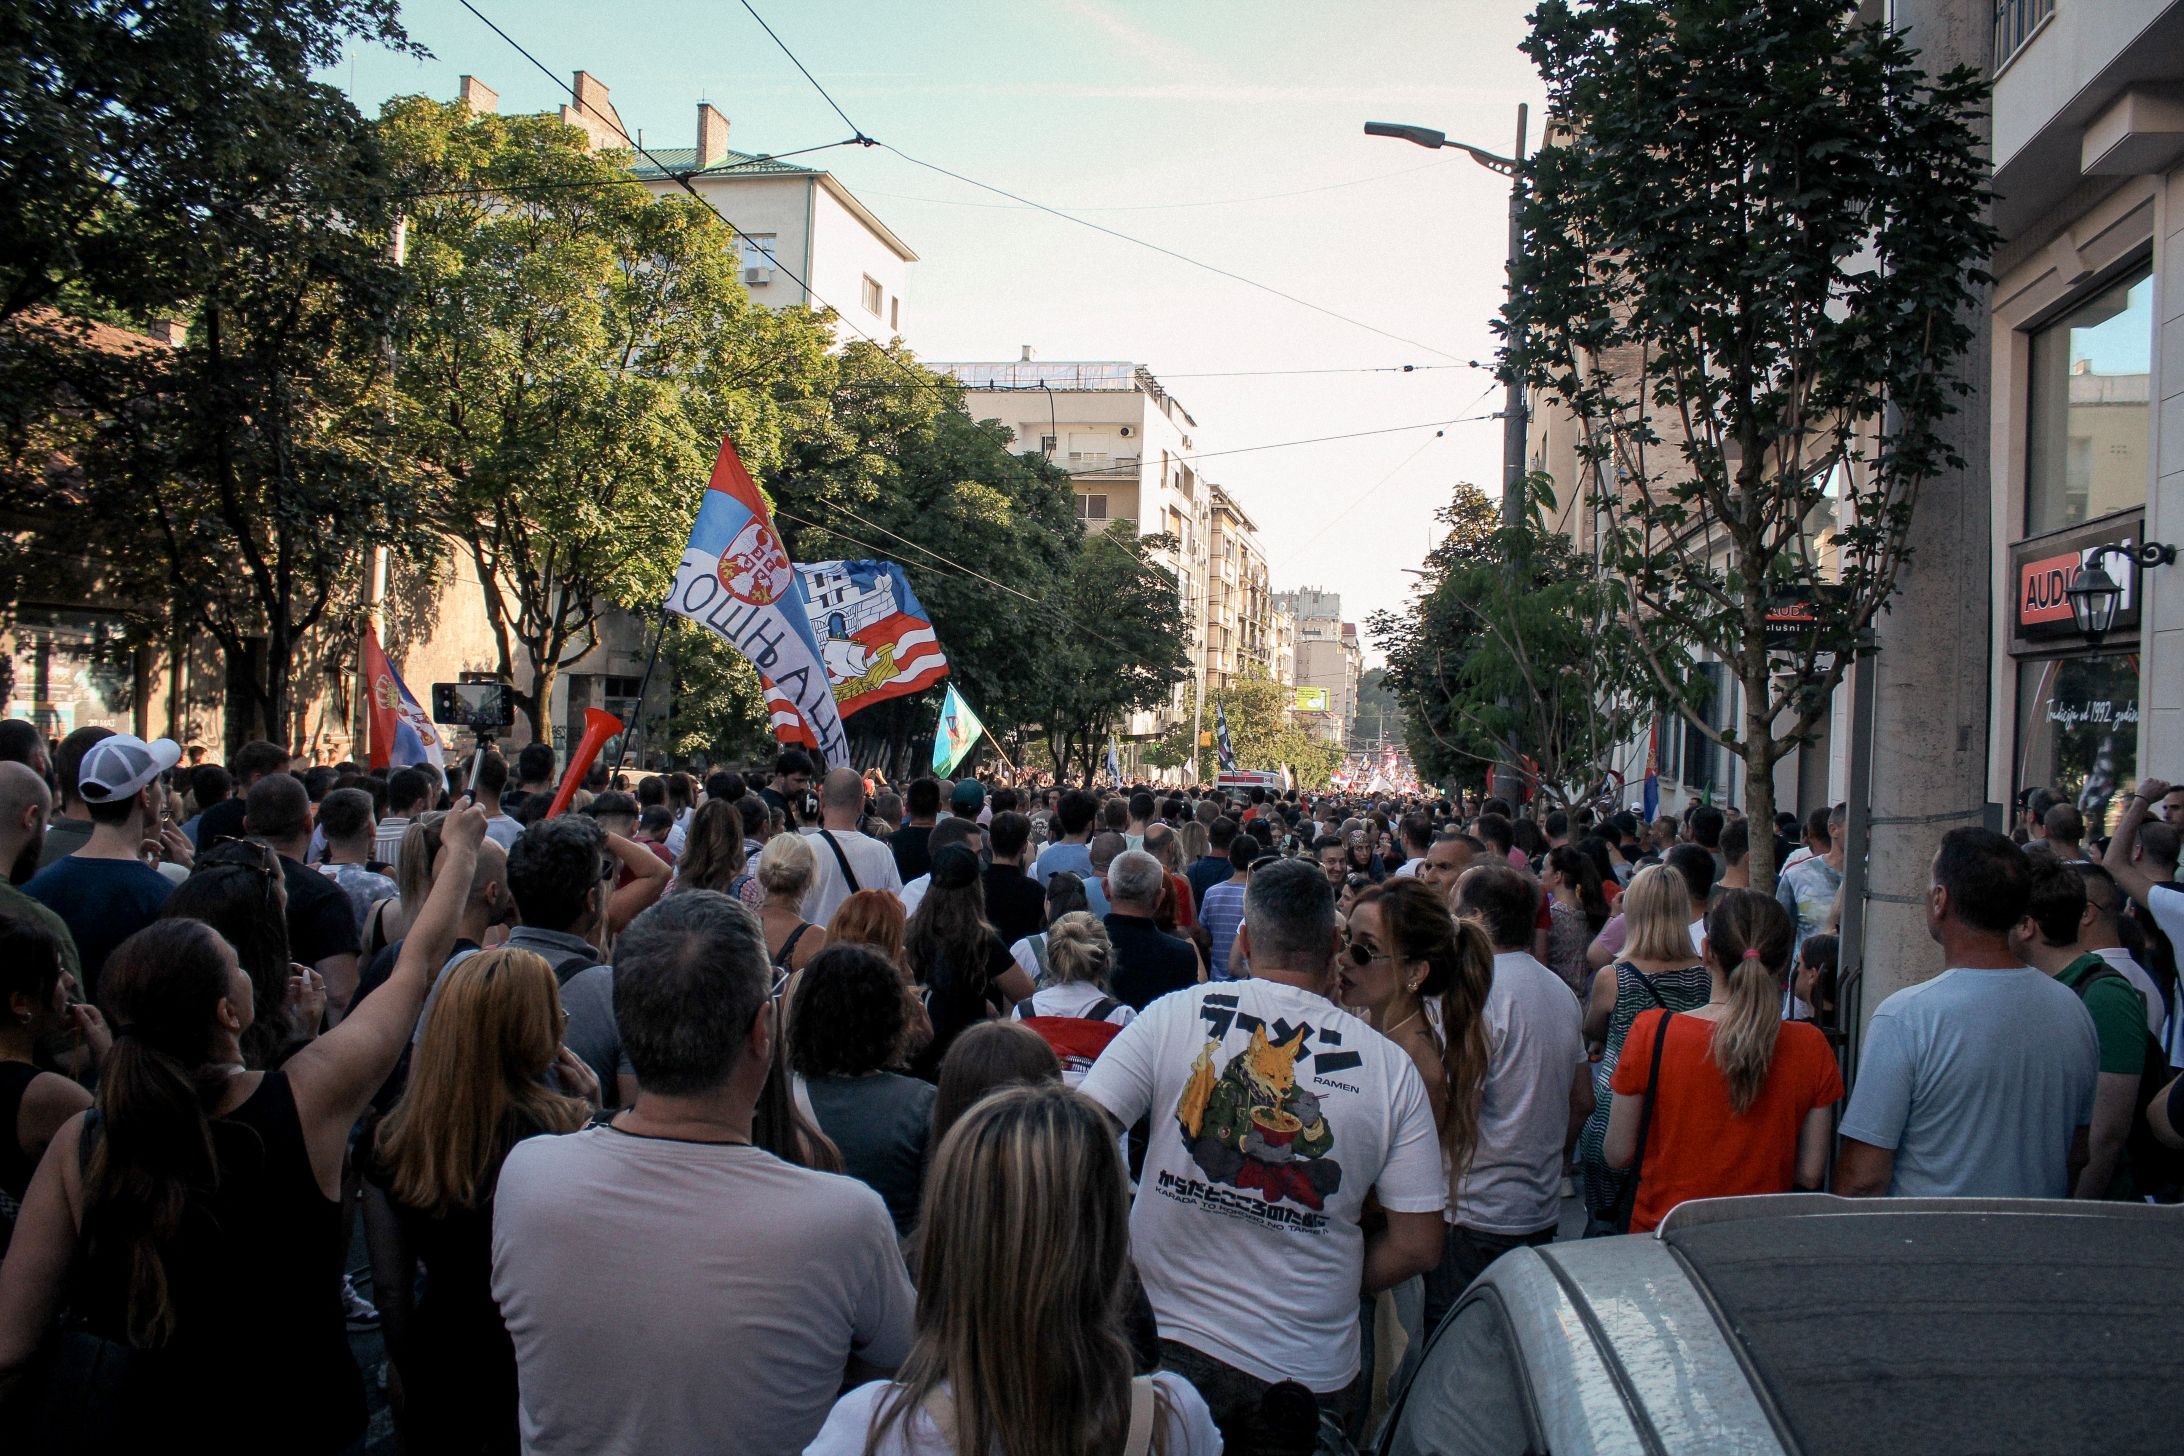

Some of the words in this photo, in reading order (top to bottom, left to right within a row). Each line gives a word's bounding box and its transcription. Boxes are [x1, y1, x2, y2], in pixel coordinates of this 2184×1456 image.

[1765, 624, 1800, 632] slušni
[2079, 701, 2091, 721] od
[2112, 700, 2139, 731] godin
[1313, 1076, 1361, 1095] RAMEN
[1155, 1186, 1198, 1205] KARADA
[1202, 1202, 1217, 1211] TO
[1267, 1221, 1285, 1231] NO
